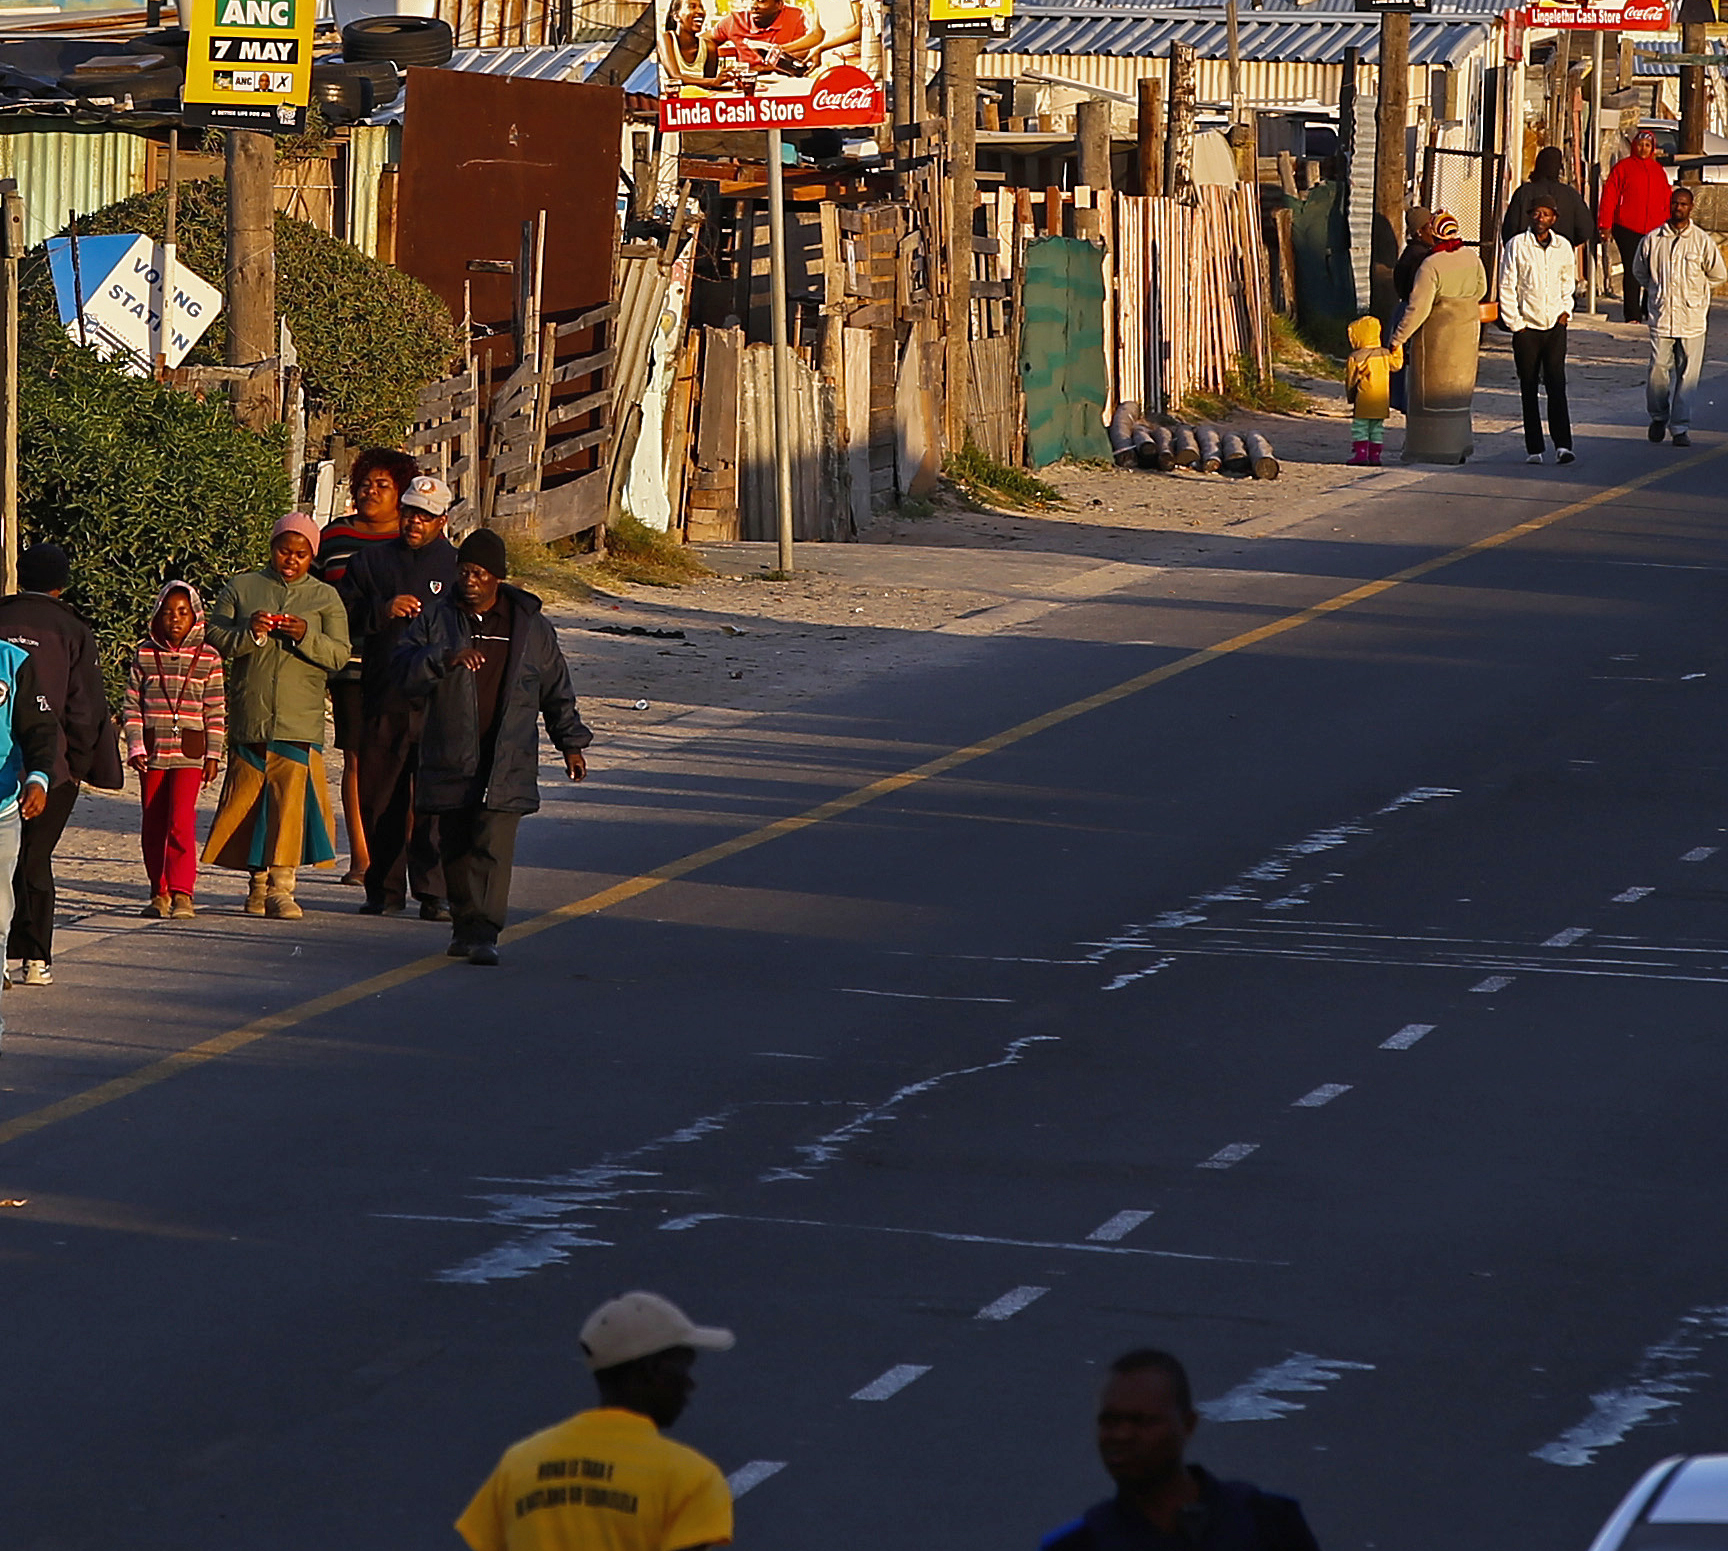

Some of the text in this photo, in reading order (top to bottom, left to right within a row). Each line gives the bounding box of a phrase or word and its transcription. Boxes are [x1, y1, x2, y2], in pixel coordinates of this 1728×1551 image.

[221, 0, 289, 26] ANC
[1576, 9, 1597, 24] Cash
[1598, 9, 1621, 24] Store
[1623, 5, 1665, 21] Coca-Cola
[214, 40, 294, 61] 7 MAY
[812, 85, 875, 111] Coca-Cola
[666, 99, 804, 125] Linda Cash Store
[133, 256, 203, 318] VONG
[108, 284, 190, 352] STATIN
